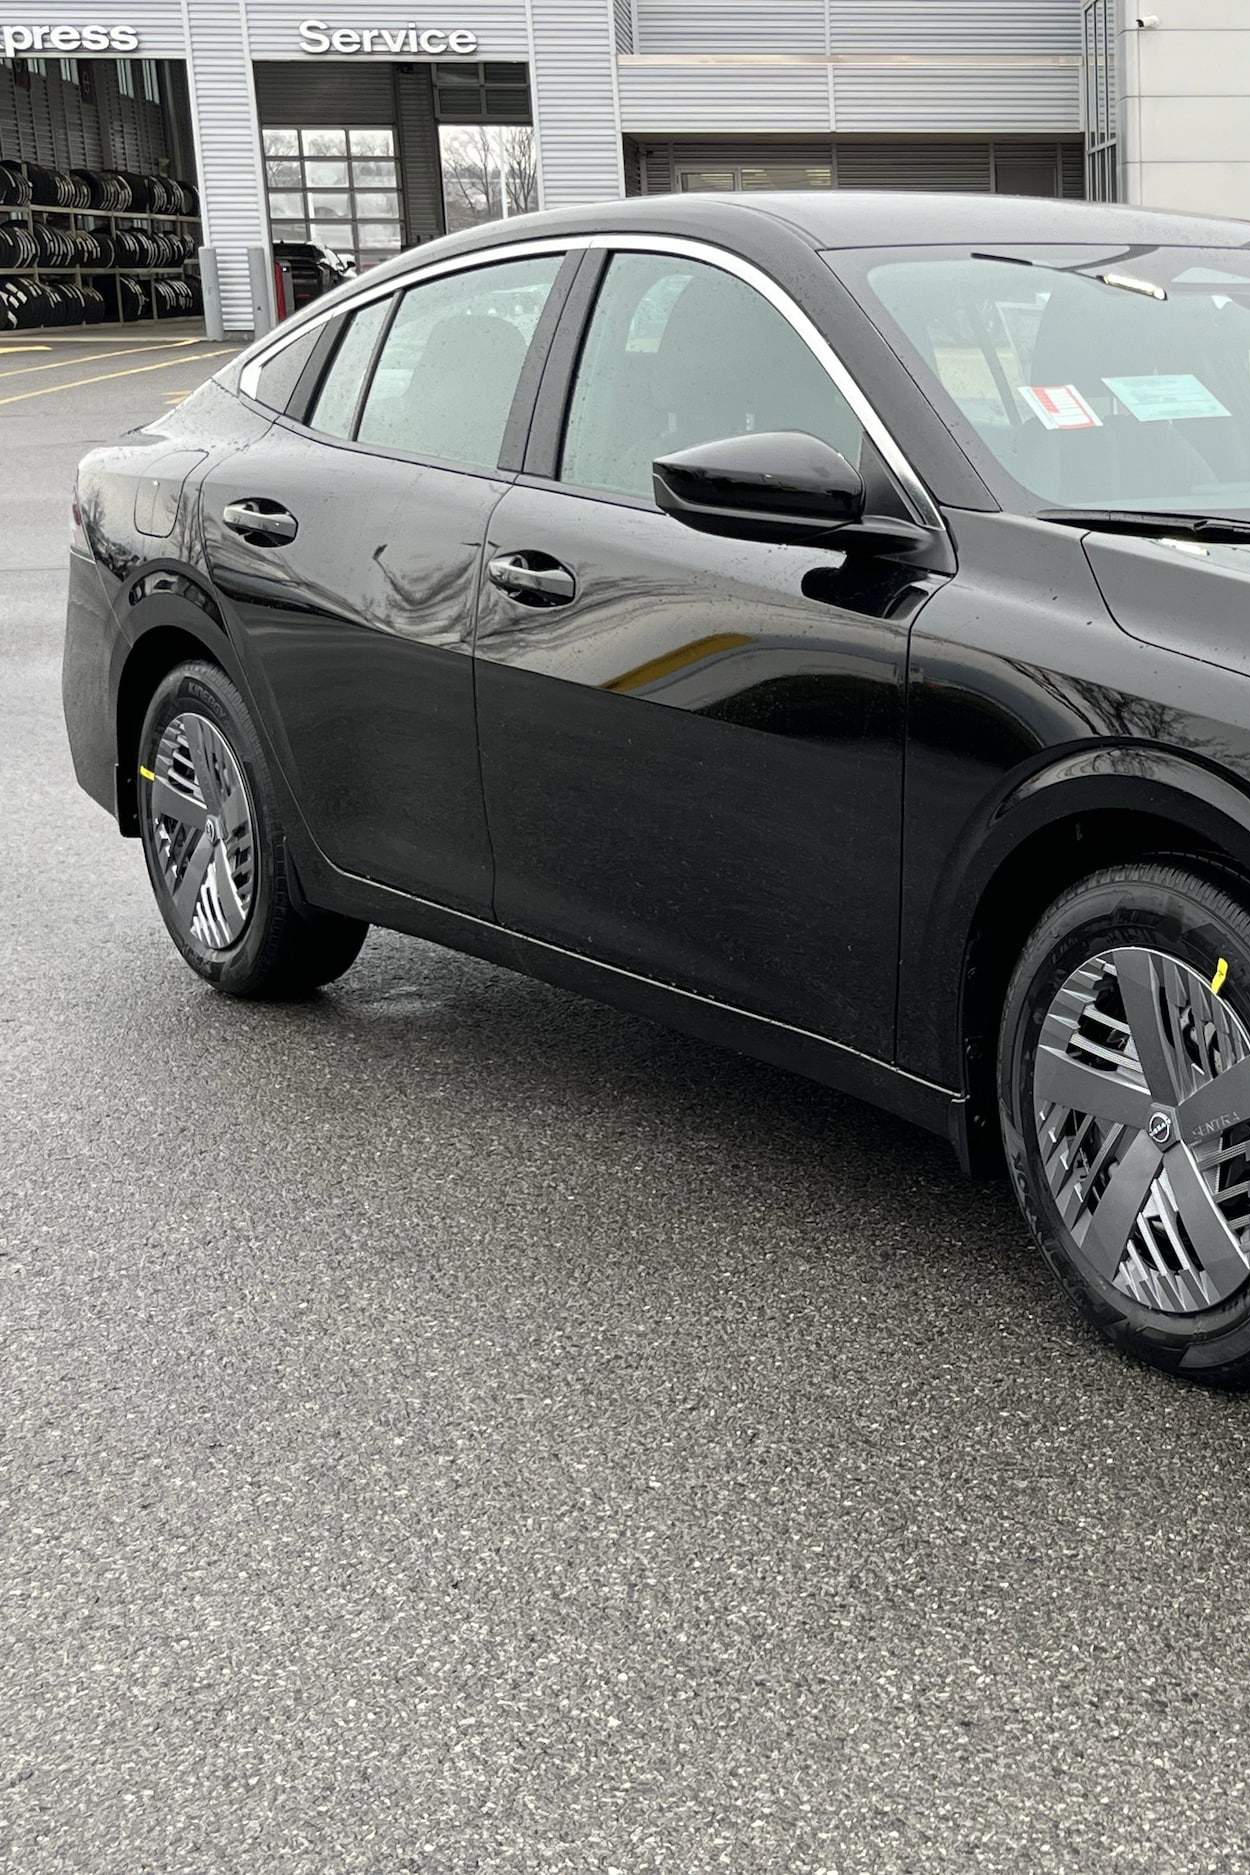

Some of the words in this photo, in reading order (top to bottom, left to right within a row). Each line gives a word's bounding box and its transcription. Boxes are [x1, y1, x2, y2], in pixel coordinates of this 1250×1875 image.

[0, 25, 139, 58] press
[299, 19, 479, 54] Service
[1191, 1111, 1241, 1138] SENTRA
